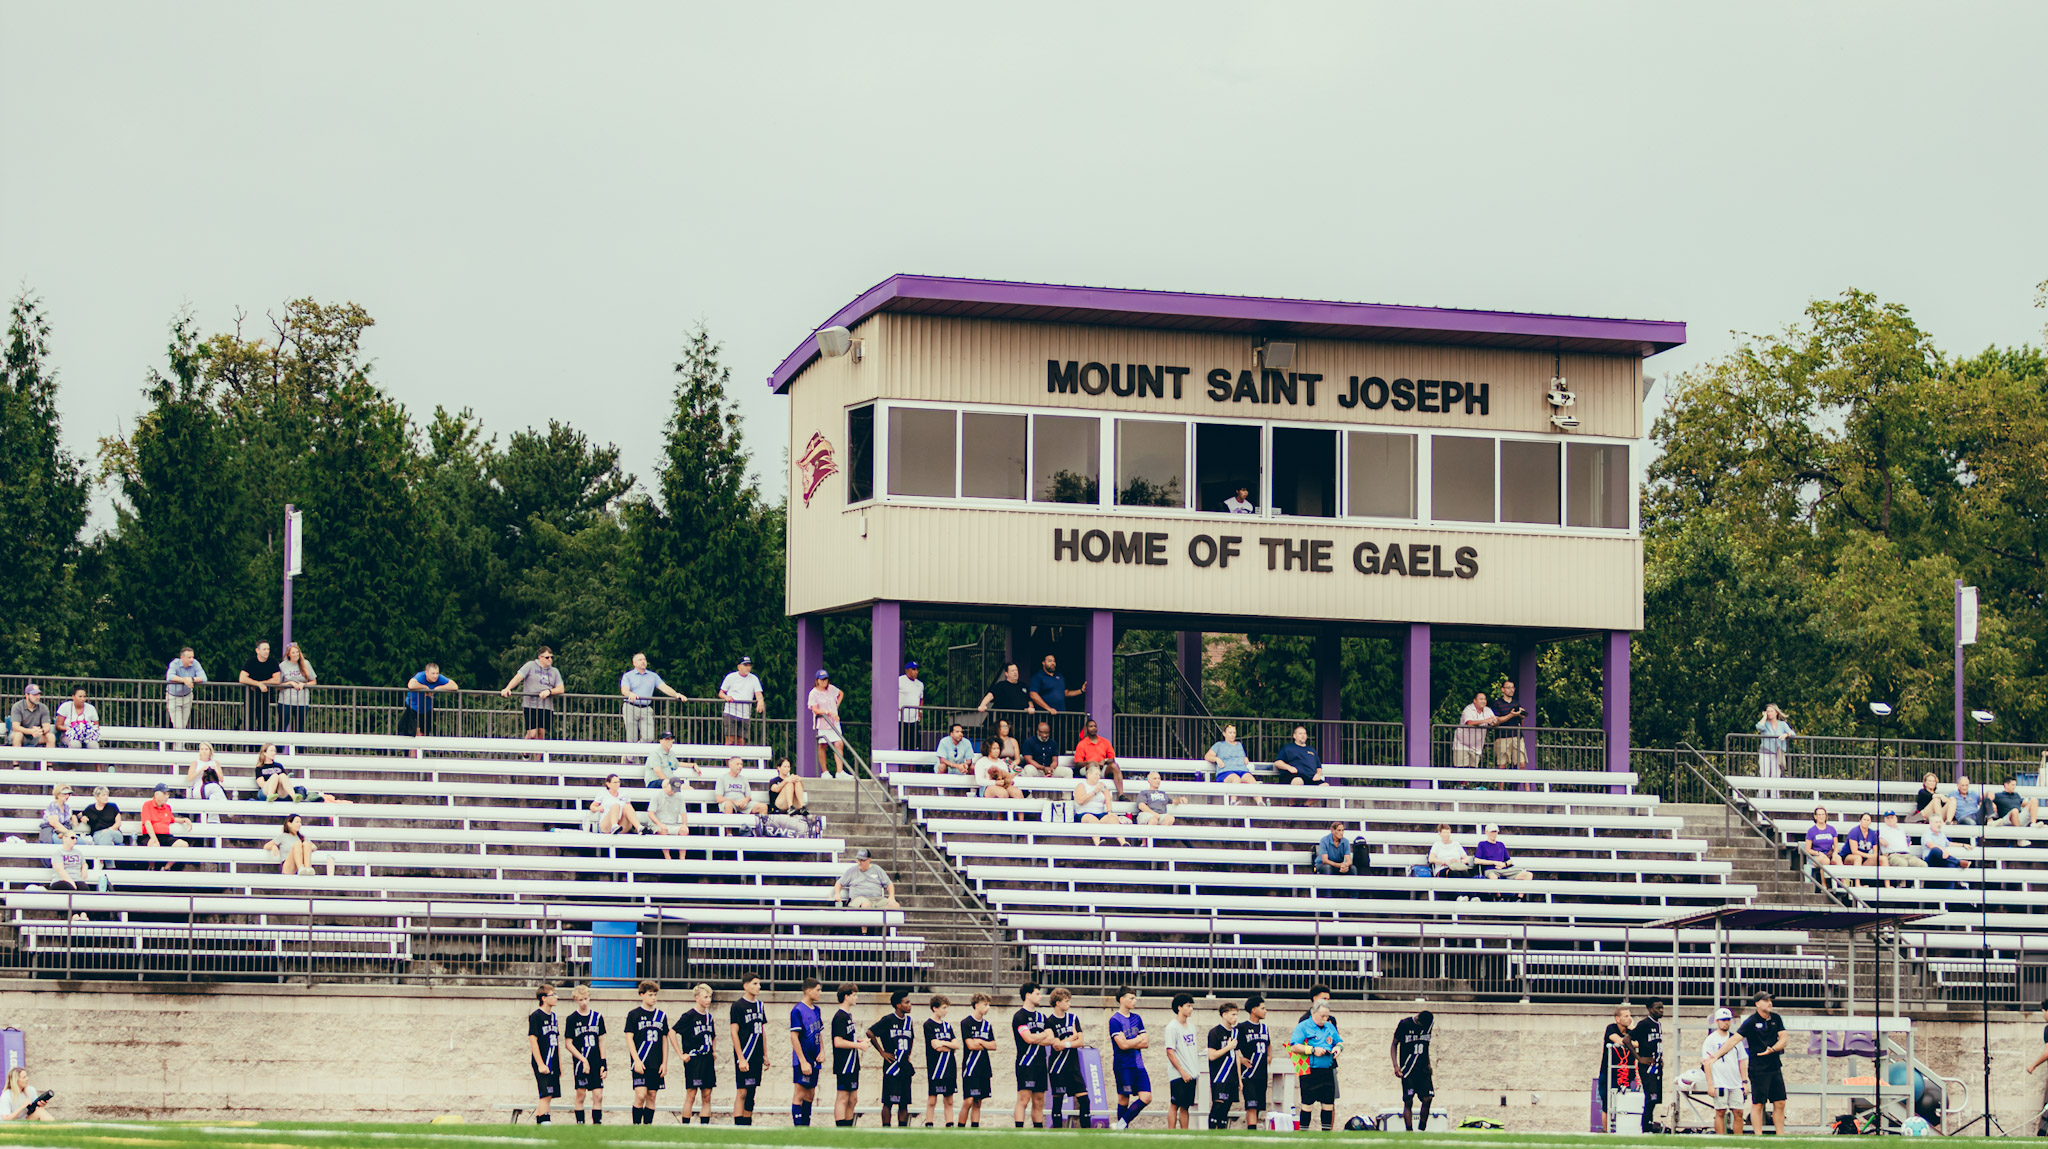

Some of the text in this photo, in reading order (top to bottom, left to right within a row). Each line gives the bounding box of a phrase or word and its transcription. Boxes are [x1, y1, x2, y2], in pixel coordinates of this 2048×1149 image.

[1048, 360, 1490, 415] MOUNT SAINT JOSEPH
[1055, 528, 1479, 579] HOME OF THE GAELS
[766, 826, 799, 838] RAVE
[584, 1034, 596, 1047] 16
[646, 1029, 658, 1042] 23
[1414, 1043, 1424, 1055] 18
